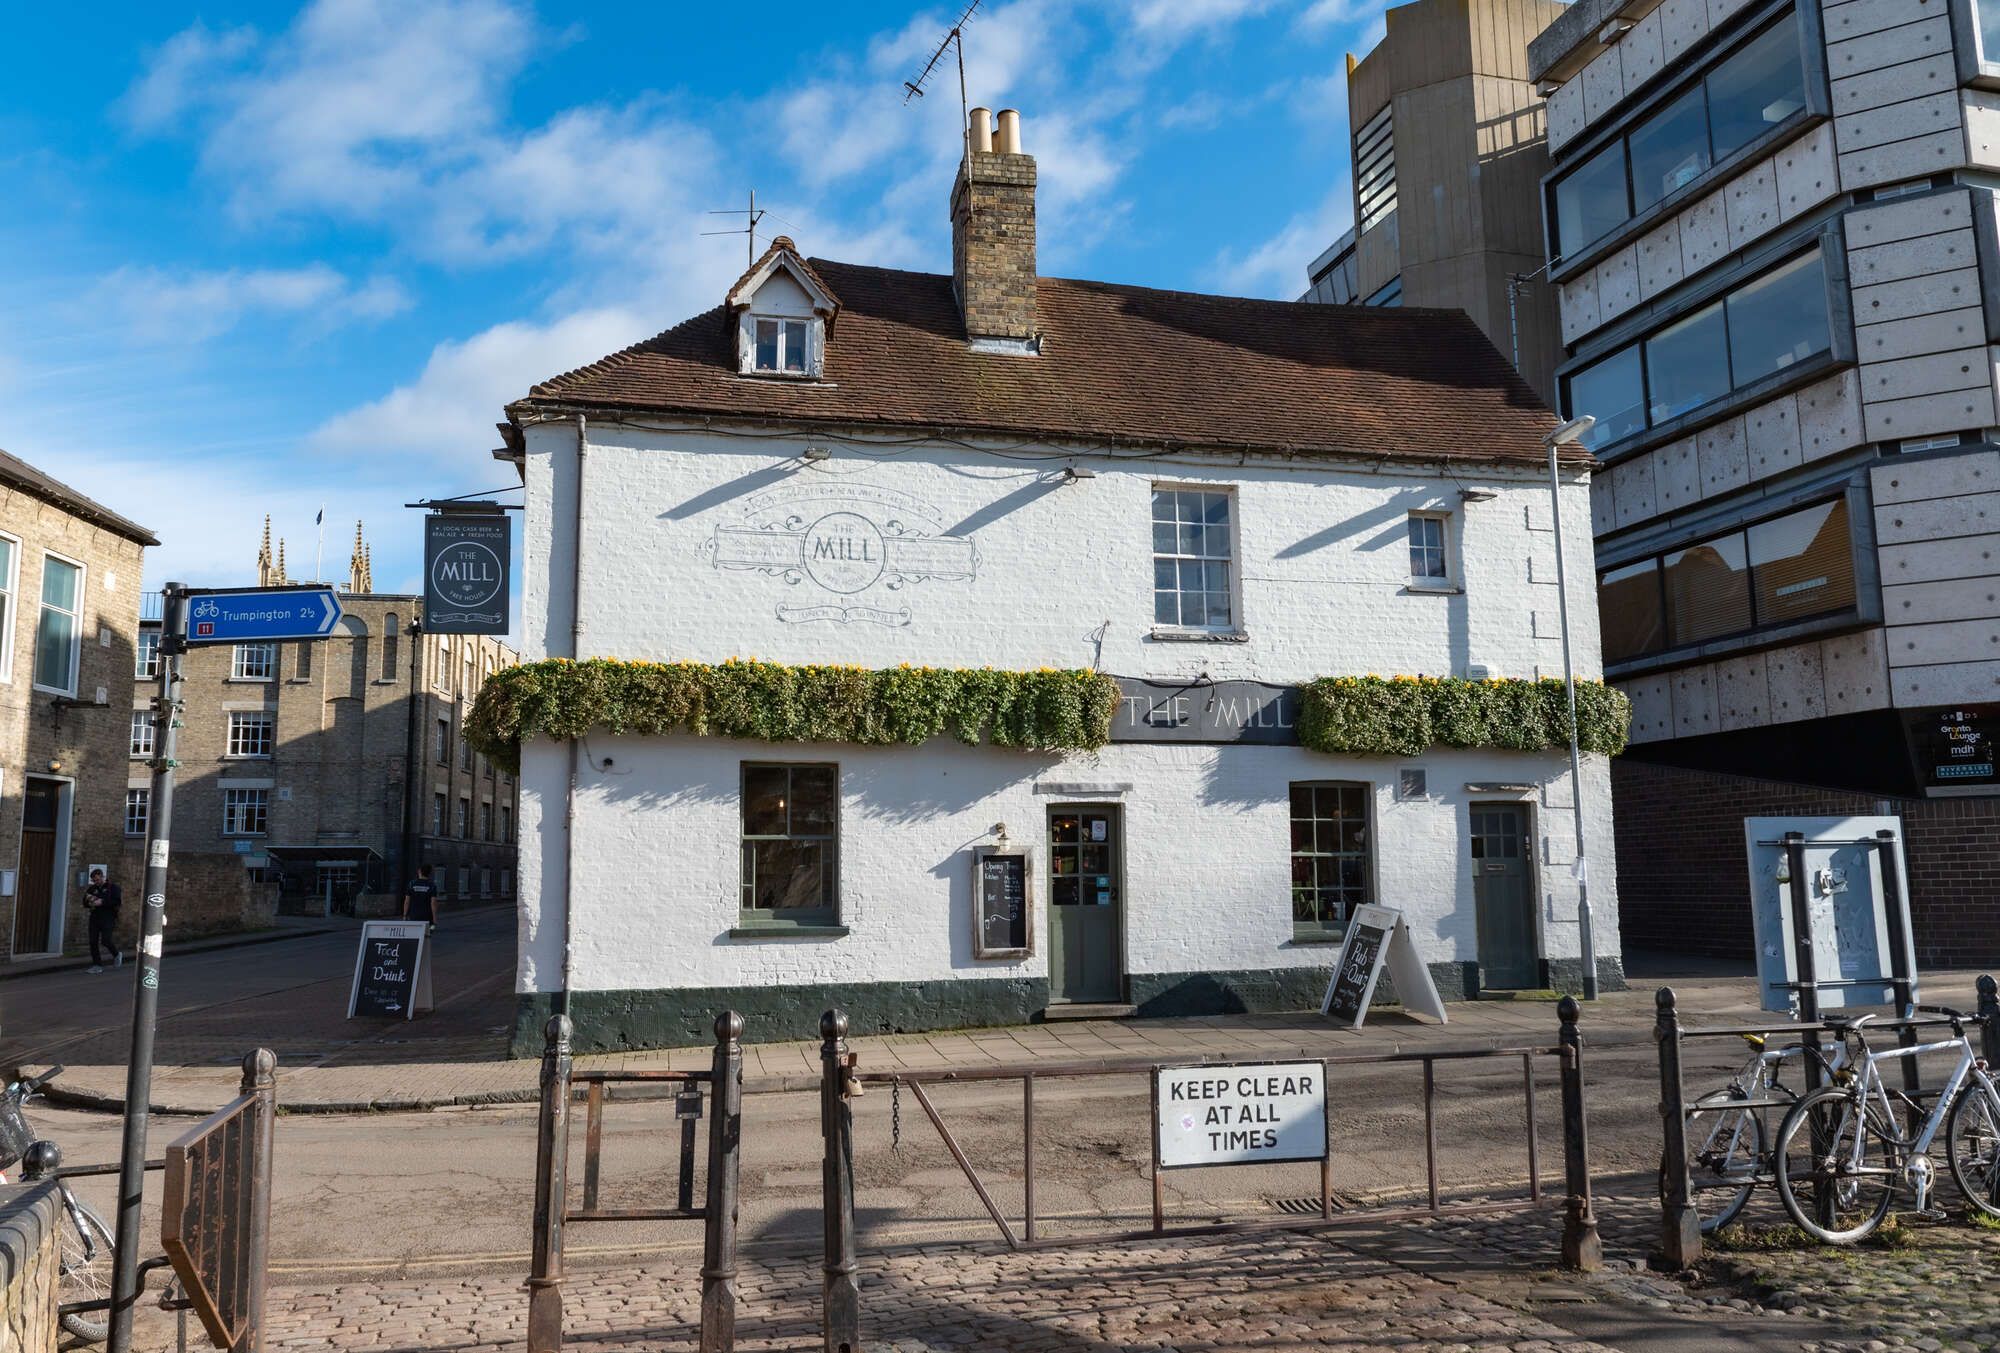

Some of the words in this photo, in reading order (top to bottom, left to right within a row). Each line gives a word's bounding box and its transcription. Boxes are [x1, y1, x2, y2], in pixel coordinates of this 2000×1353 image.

[833, 523, 855, 534] THE
[458, 551, 477, 560] THE
[812, 536, 877, 562] MILL
[440, 562, 494, 581] MILL
[449, 591, 463, 601] FREE
[464, 591, 485, 601] HOUSE
[223, 610, 290, 622] Trumpington
[202, 625, 210, 633] 11
[1121, 695, 1190, 727] THE
[1214, 697, 1293, 728] MILL
[1949, 732, 1981, 744] Lounge
[1951, 745, 1975, 754] mdh
[390, 927, 407, 937] MILL
[375, 942, 399, 957] Food
[1351, 943, 1367, 965] Pub
[383, 958, 398, 966] and
[373, 966, 407, 983] Drink
[1347, 963, 1369, 992] Quiz
[1171, 1079, 1229, 1101] KEEP
[1237, 1076, 1313, 1098] CLEAR
[1205, 1106, 1232, 1125] AT
[1238, 1104, 1281, 1124] ALL
[1208, 1129, 1278, 1151] TIMES
